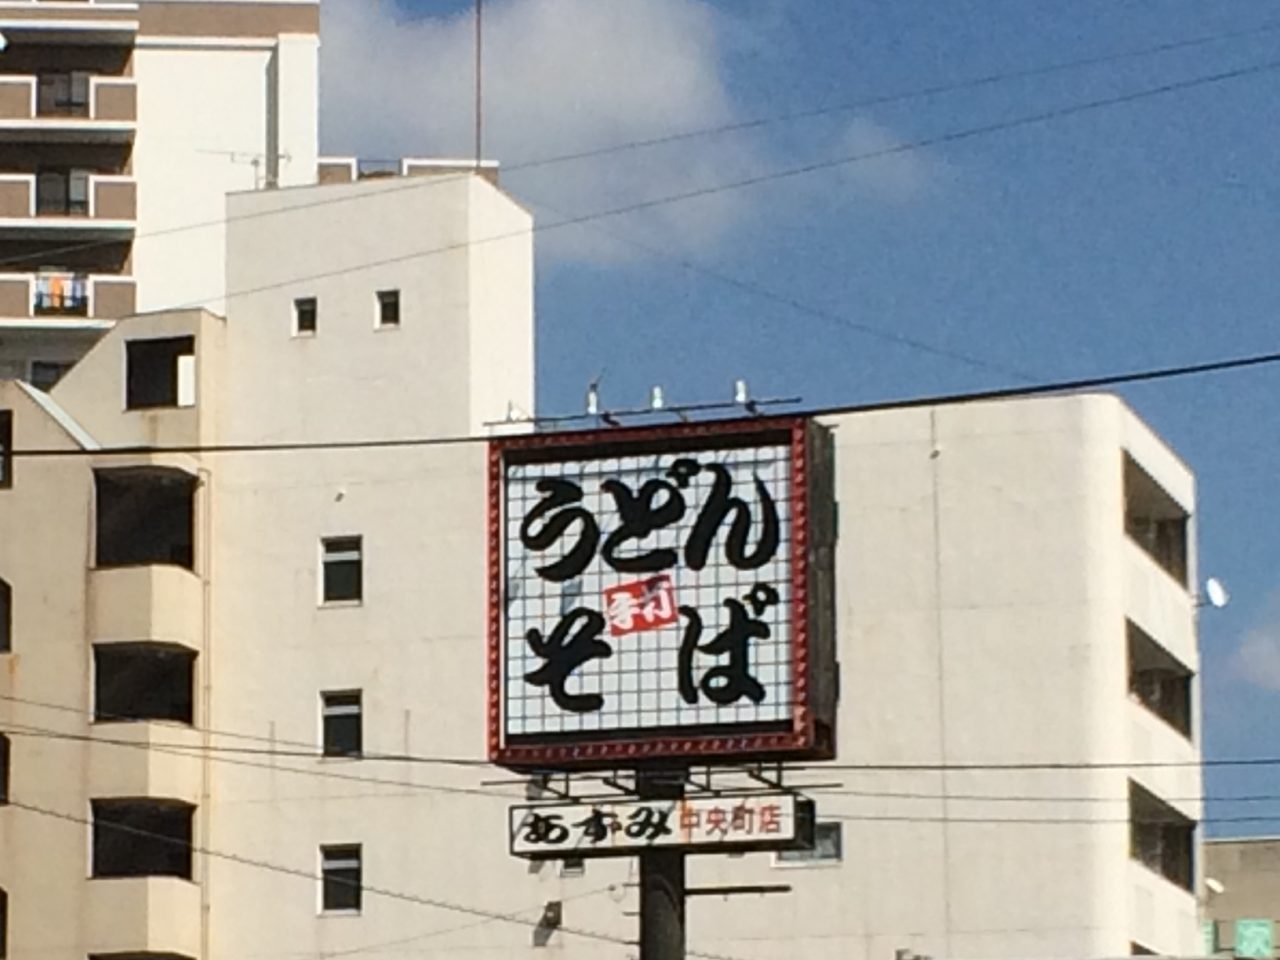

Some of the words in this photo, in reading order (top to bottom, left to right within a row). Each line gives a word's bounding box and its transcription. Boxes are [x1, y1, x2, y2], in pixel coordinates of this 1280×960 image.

[521, 458, 780, 582] うどん
[524, 582, 780, 712] そば
[522, 806, 673, 844] あずみ
[680, 801, 781, 840] 中央町店
